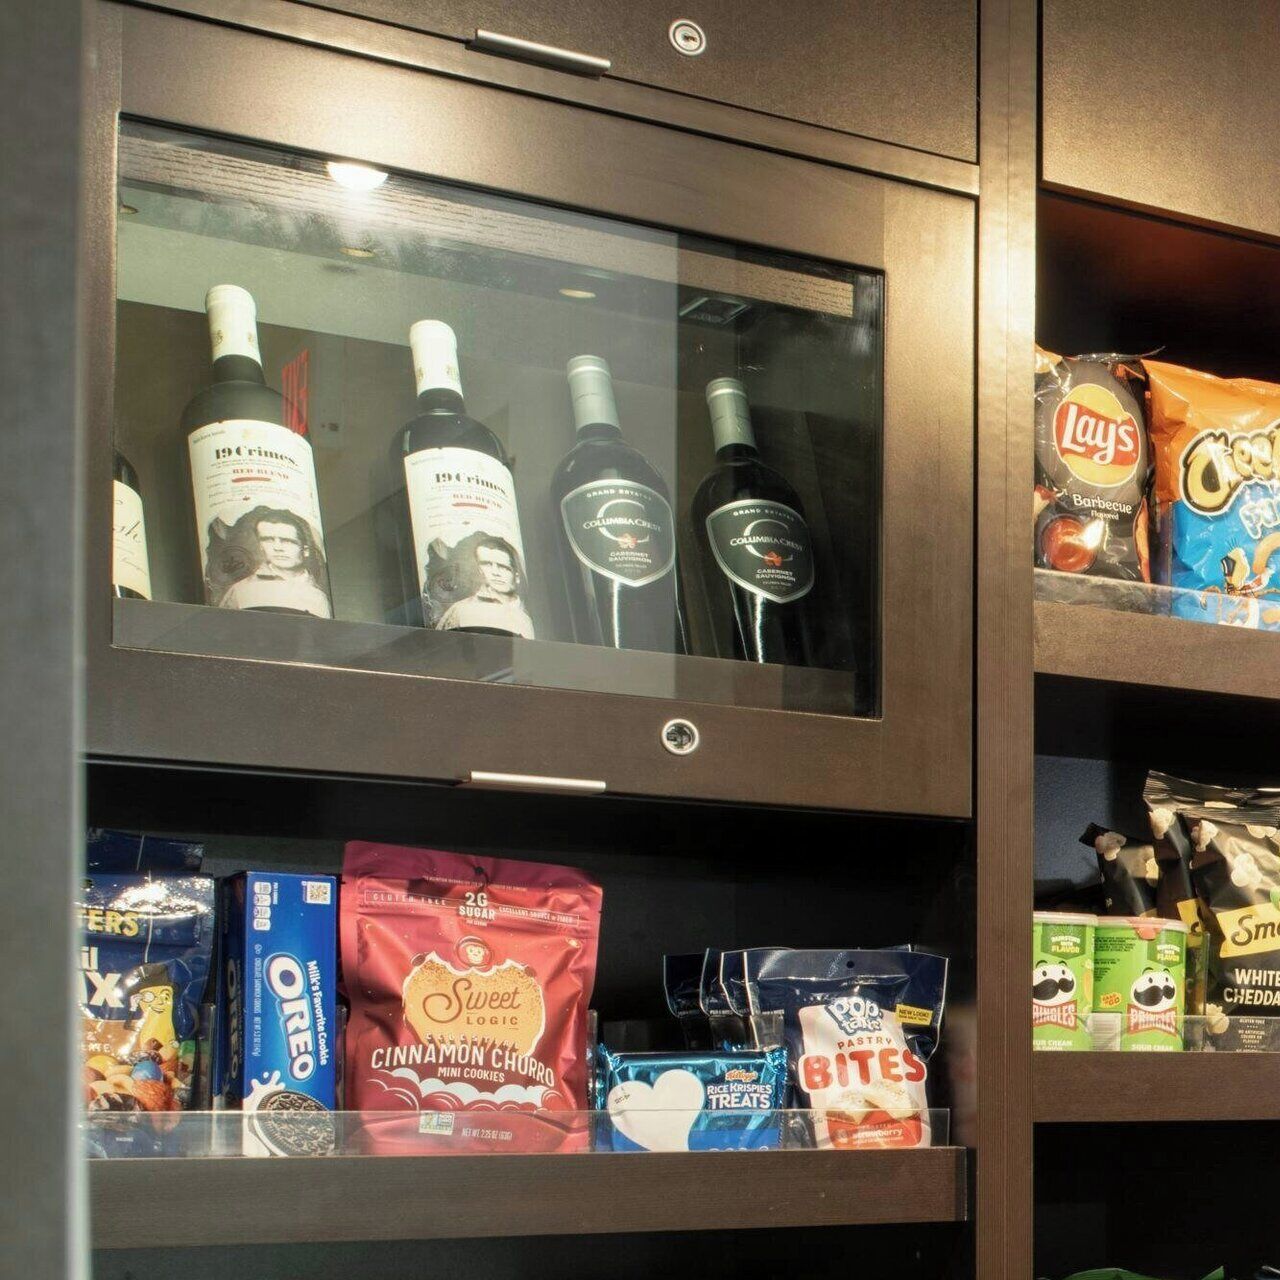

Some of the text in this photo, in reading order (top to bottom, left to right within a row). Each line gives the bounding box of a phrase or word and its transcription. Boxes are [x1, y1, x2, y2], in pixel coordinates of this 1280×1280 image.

[1062, 403, 1134, 465] Lay's
[1073, 493, 1132, 514] Barbecue
[583, 517, 634, 529] COLUMBIA
[730, 535, 780, 546] COLUMBIA
[756, 574, 796, 582] SAUVIGNON
[465, 892, 488, 906] 2G
[459, 906, 495, 920] SUGAR
[422, 978, 521, 1024] Sweet
[268, 955, 315, 1080] OREO
[466, 1016, 519, 1026] LOGIC
[837, 1036, 893, 1049] PASTRY
[371, 1044, 555, 1088] CINNAMON CHURRO
[804, 1048, 926, 1090] BITES
[437, 1067, 506, 1082] MINI COOKIES
[707, 1082, 772, 1094] RICE KRISPIES
[708, 1094, 770, 1110] TREATS
